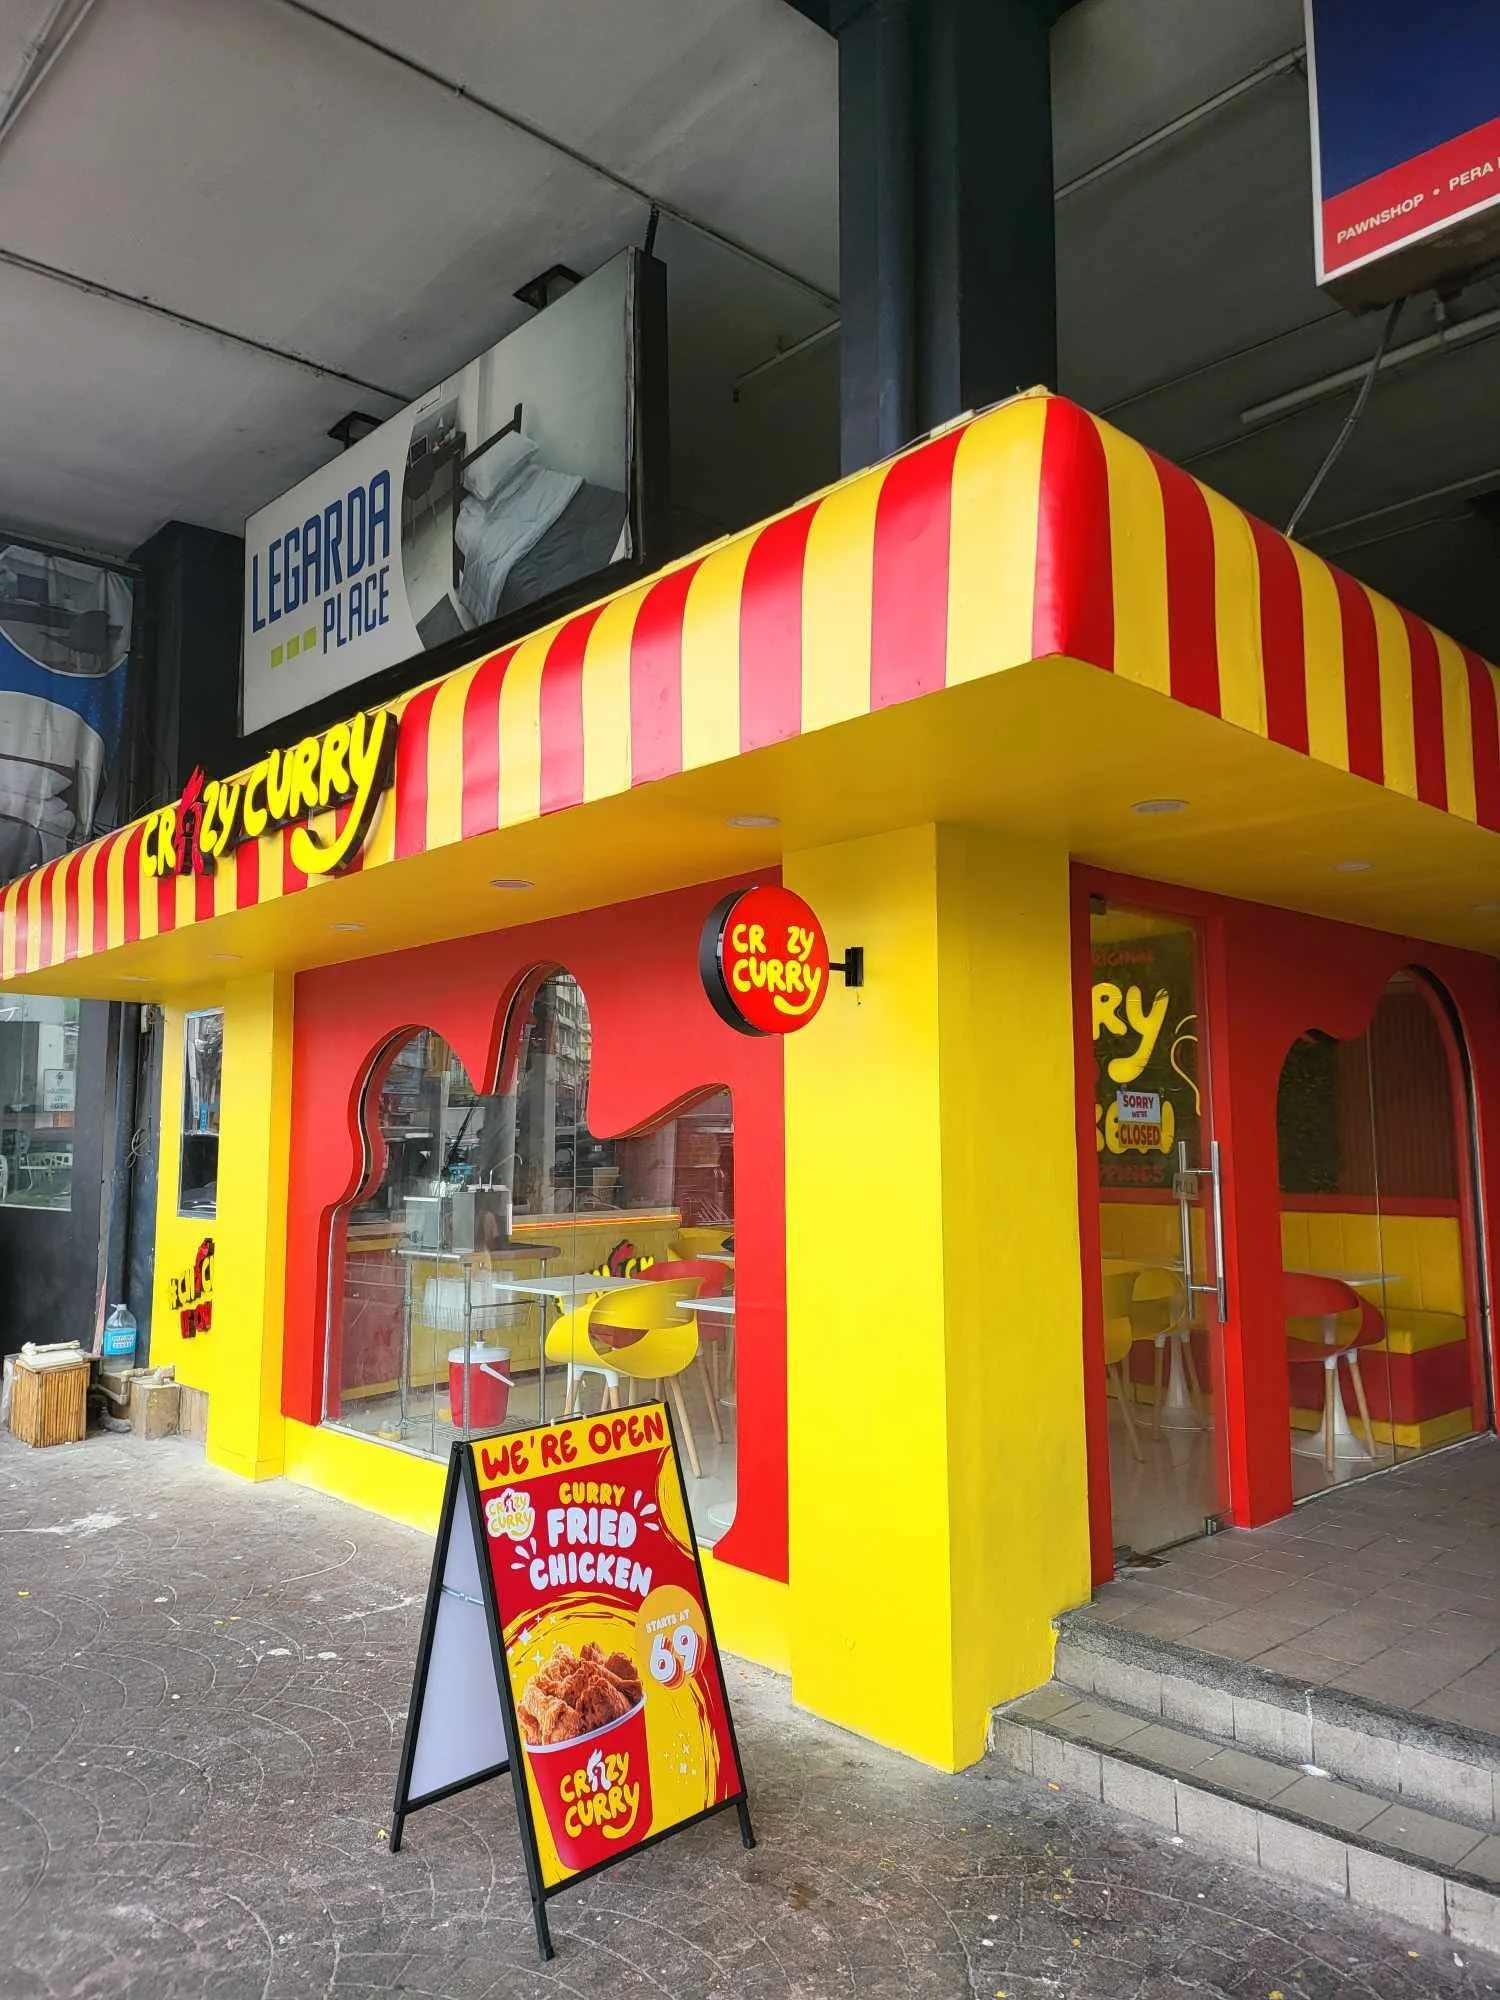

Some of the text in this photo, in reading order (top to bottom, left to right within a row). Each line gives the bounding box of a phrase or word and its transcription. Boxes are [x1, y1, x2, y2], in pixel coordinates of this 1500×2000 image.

[1336, 162, 1494, 244] PAWNSHOP PERA
[252, 469, 391, 633] LEGARDA
[323, 565, 390, 655] PLACE
[243, 709, 389, 875] CURRY
[732, 956, 822, 1016] CURRY
[1123, 1095, 1155, 1109] SORRY
[1120, 1124, 1161, 1146] CLOSED
[481, 1411, 665, 1481] WE'RE OPEN
[558, 1481, 626, 1507] CURRY
[491, 1510, 533, 1537] CURRY
[547, 1506, 638, 1549] FRIED
[529, 1551, 653, 1597] CHICKEN
[645, 1608, 690, 1634] STARTS AT
[649, 1624, 699, 1684] 69
[564, 1782, 640, 1840] CURRY
